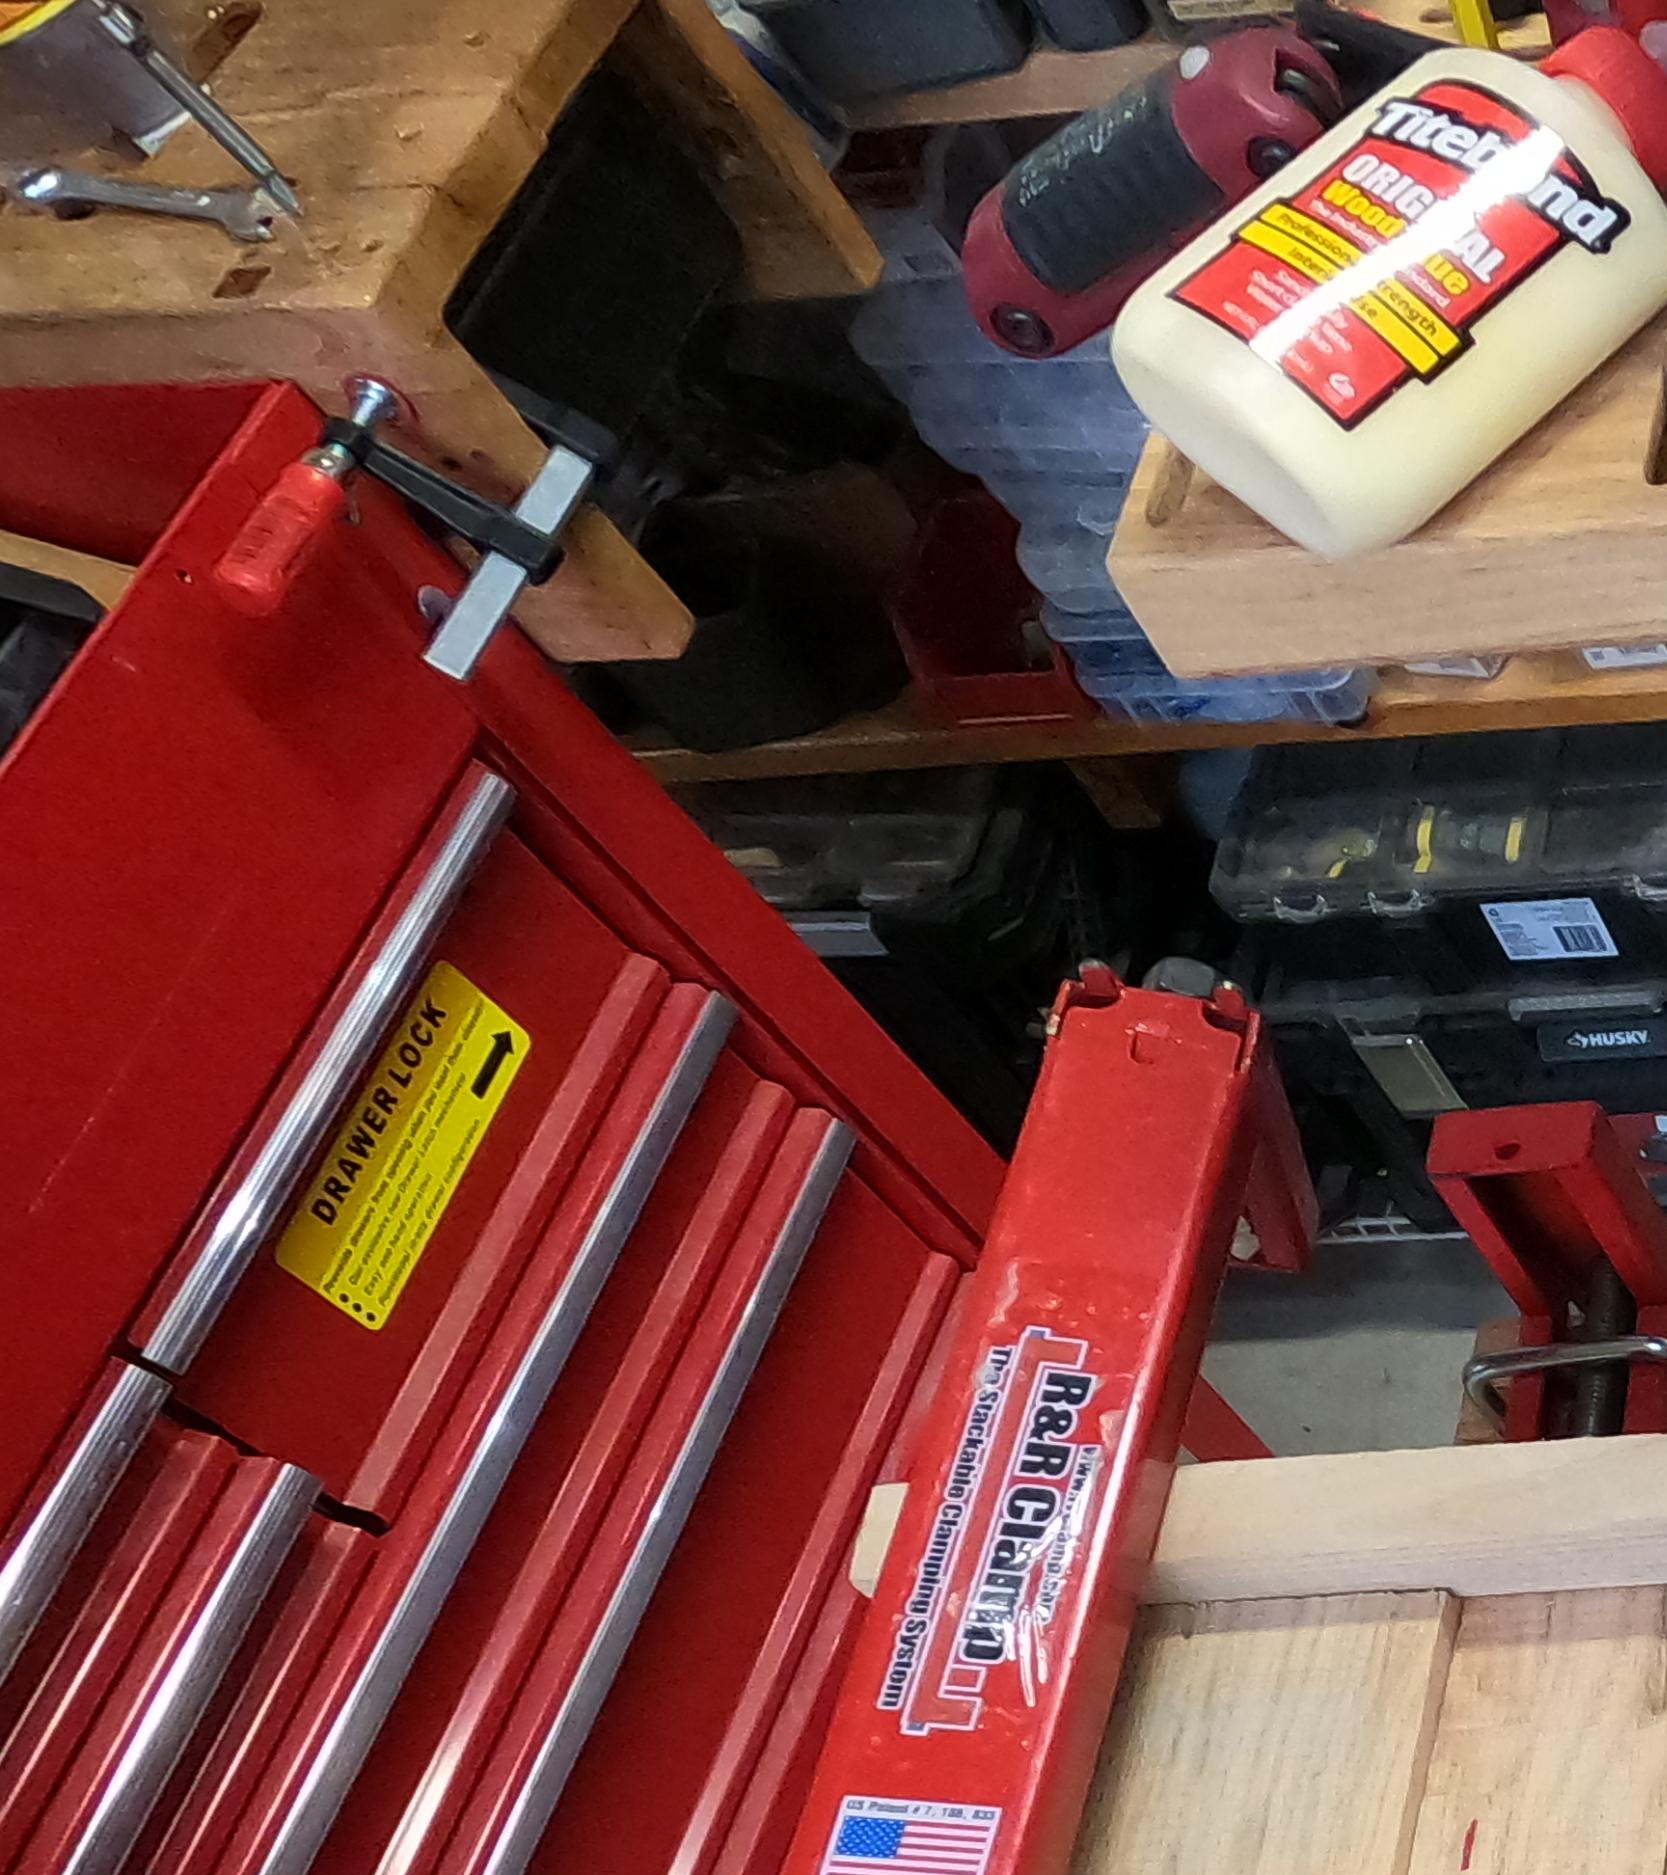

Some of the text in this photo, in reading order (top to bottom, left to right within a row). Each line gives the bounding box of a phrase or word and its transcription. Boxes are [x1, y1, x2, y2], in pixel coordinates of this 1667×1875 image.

[1322, 179, 1407, 238] Wood
[1371, 101, 1620, 247] Titebnd
[1277, 212, 1360, 265] Profession
[1588, 1030, 1649, 1046] HUSKY
[310, 1000, 447, 1227] DRAWER LOCK
[1020, 1371, 1093, 1478] R&R
